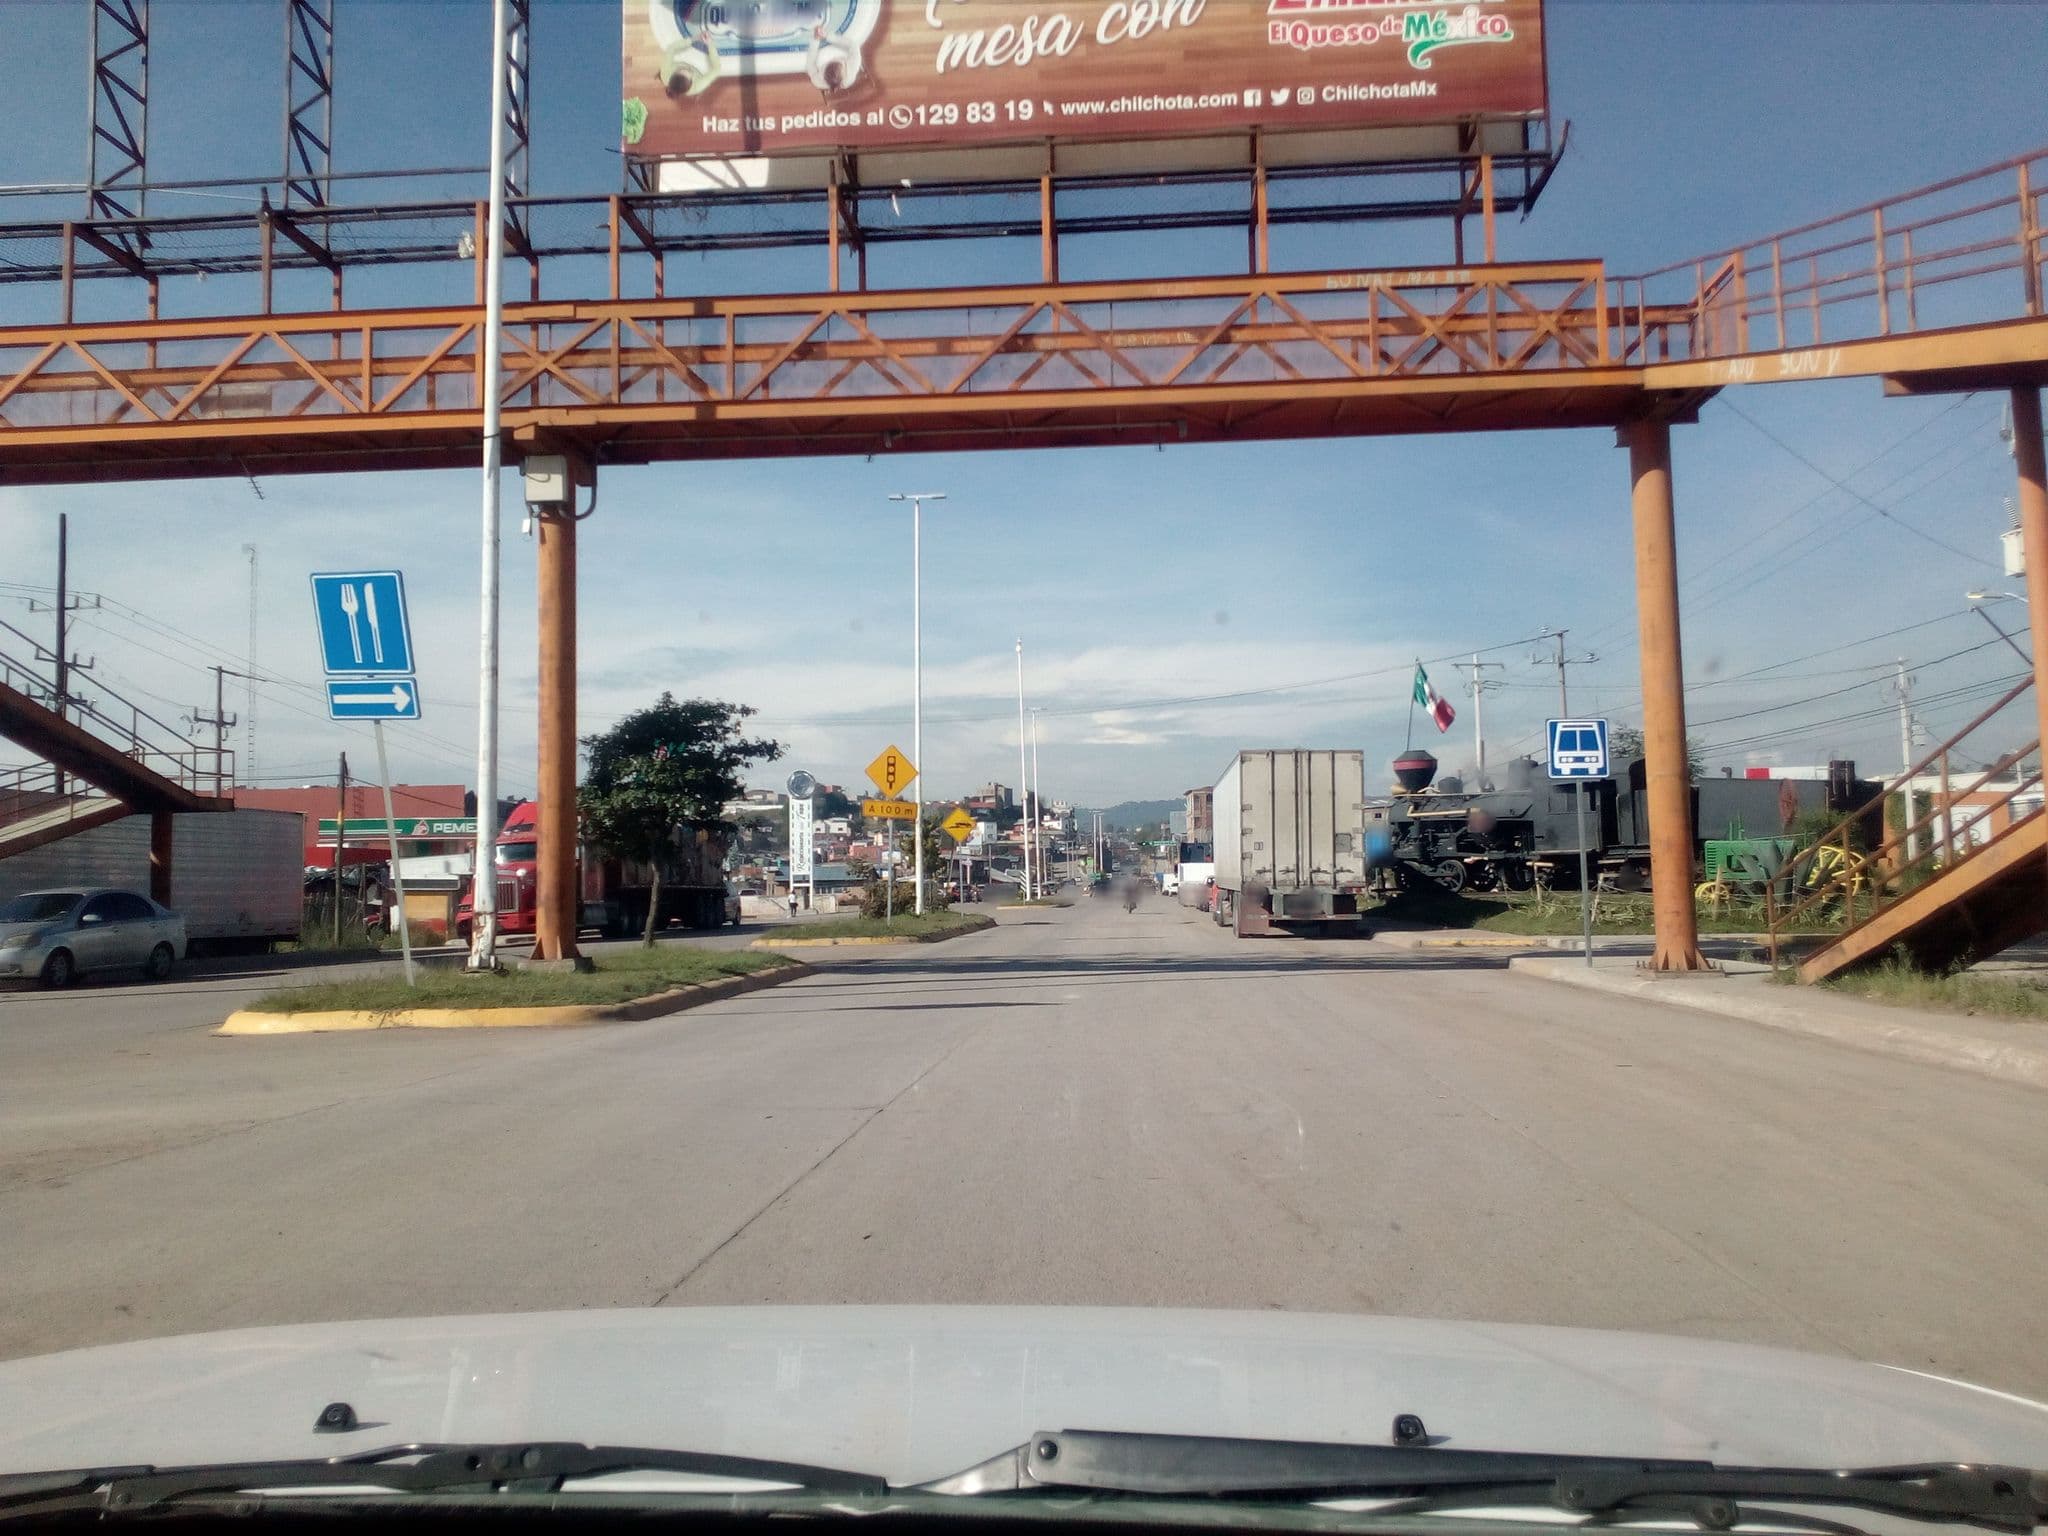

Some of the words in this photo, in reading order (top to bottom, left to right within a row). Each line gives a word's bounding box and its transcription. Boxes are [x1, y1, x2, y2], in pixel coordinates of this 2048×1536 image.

[936, 13, 1084, 73] mesa
[1096, 0, 1206, 43] con
[1269, 21, 1288, 43] El
[1290, 20, 1379, 50] Queso
[1381, 15, 1402, 35] de
[1403, 5, 1508, 42] México
[1321, 80, 1438, 102] ChilchotaMx
[1061, 92, 1238, 115] www.chilchota.com
[702, 115, 740, 133] Haz
[745, 115, 776, 131] tus
[781, 110, 860, 133] pedidos
[866, 108, 884, 126] al
[915, 103, 959, 125] 129
[966, 101, 996, 124] 83
[1004, 99, 1034, 121] 19
[868, 805, 876, 814] A
[880, 805, 901, 815] 100
[433, 823, 478, 833] PEME
